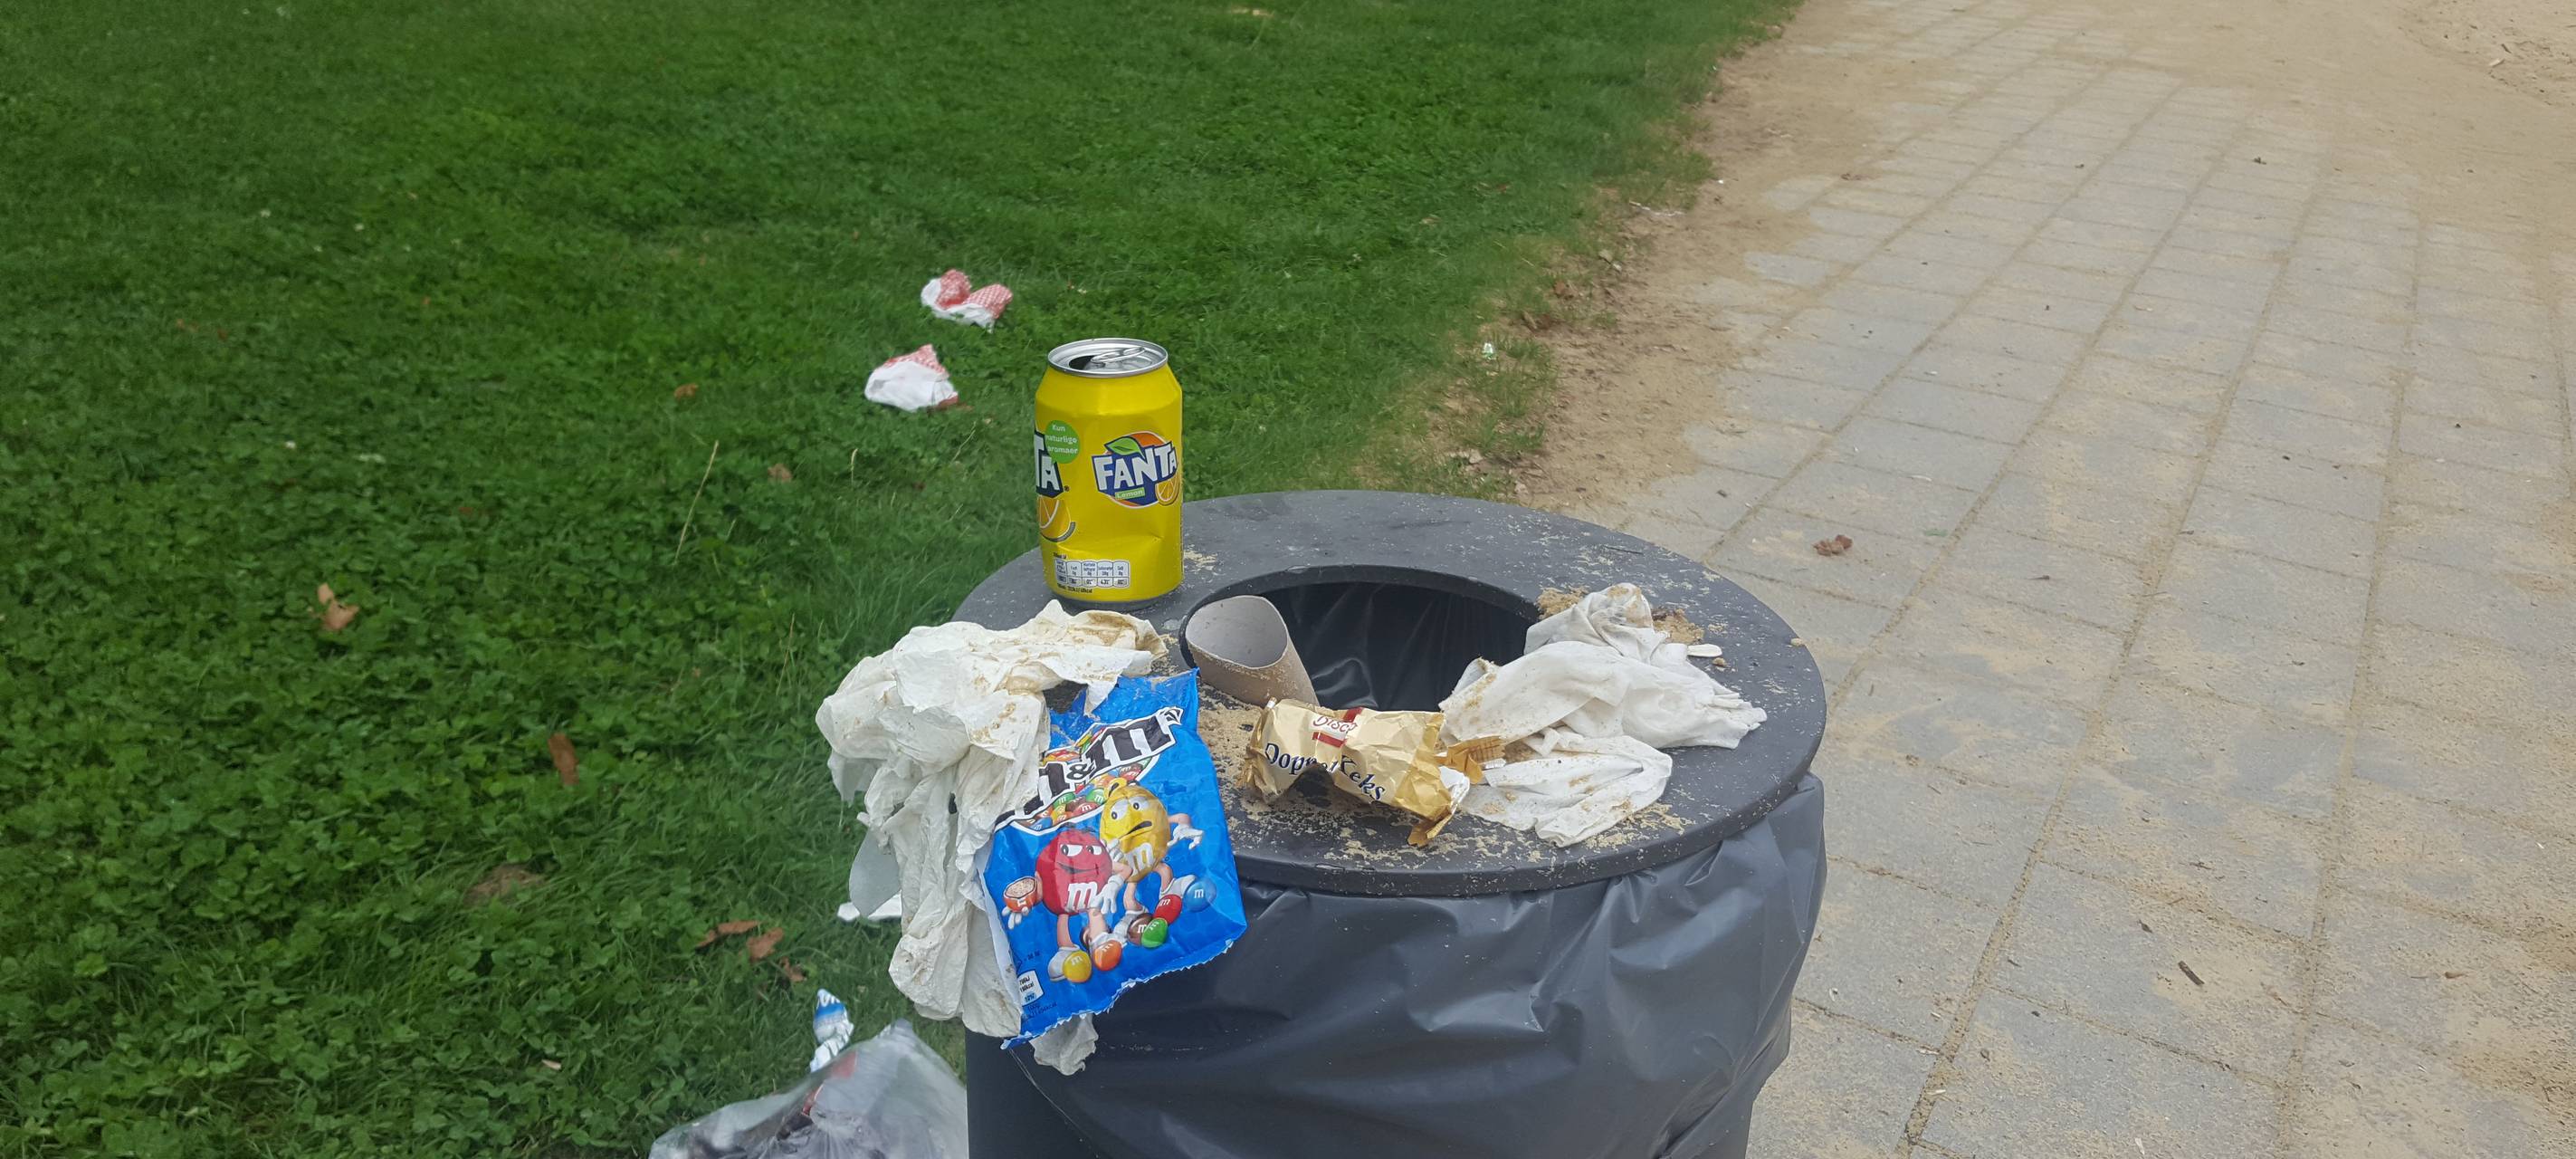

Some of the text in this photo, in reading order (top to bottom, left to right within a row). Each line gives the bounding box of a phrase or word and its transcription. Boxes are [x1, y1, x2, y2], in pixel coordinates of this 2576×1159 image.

[1052, 424, 1065, 432] Kun
[1093, 444, 1178, 491] FANTA
[1117, 490, 1144, 499] Lemon
[1340, 754, 1386, 800] Keks
[1067, 881, 1099, 913] m
[1193, 888, 1205, 899] m
